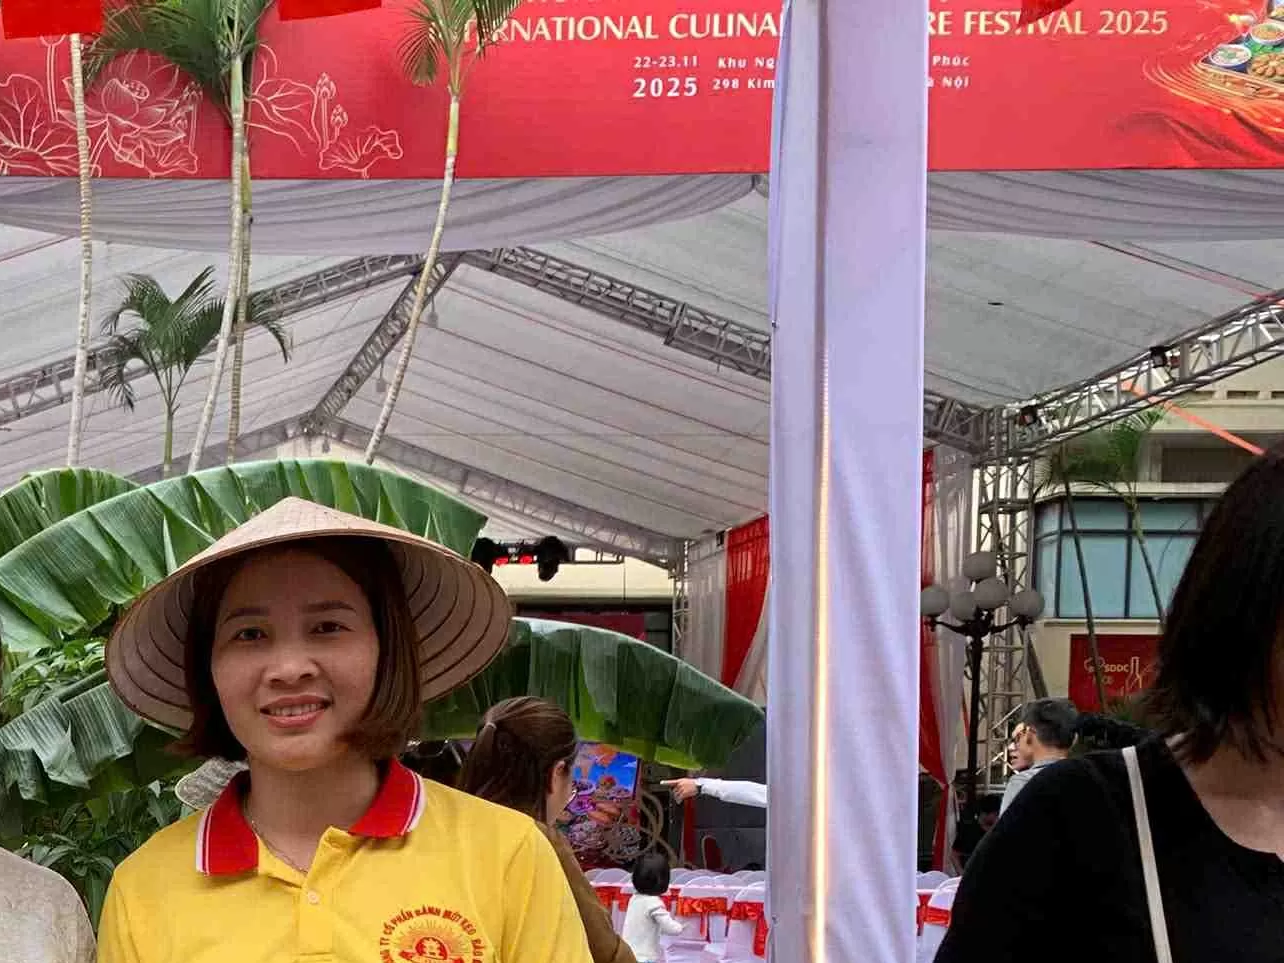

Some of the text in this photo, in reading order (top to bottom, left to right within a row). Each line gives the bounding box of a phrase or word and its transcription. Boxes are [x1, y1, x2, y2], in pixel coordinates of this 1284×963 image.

[668, 12, 783, 39] CULINA
[1099, 10, 1168, 35] 2025
[633, 56, 698, 69] 22-23.11
[718, 56, 747, 69] Khu
[932, 54, 970, 67] Phúc
[633, 77, 698, 97] 2025
[712, 78, 740, 90] 298
[747, 77, 776, 90] Kim
[942, 75, 969, 89] Nội
